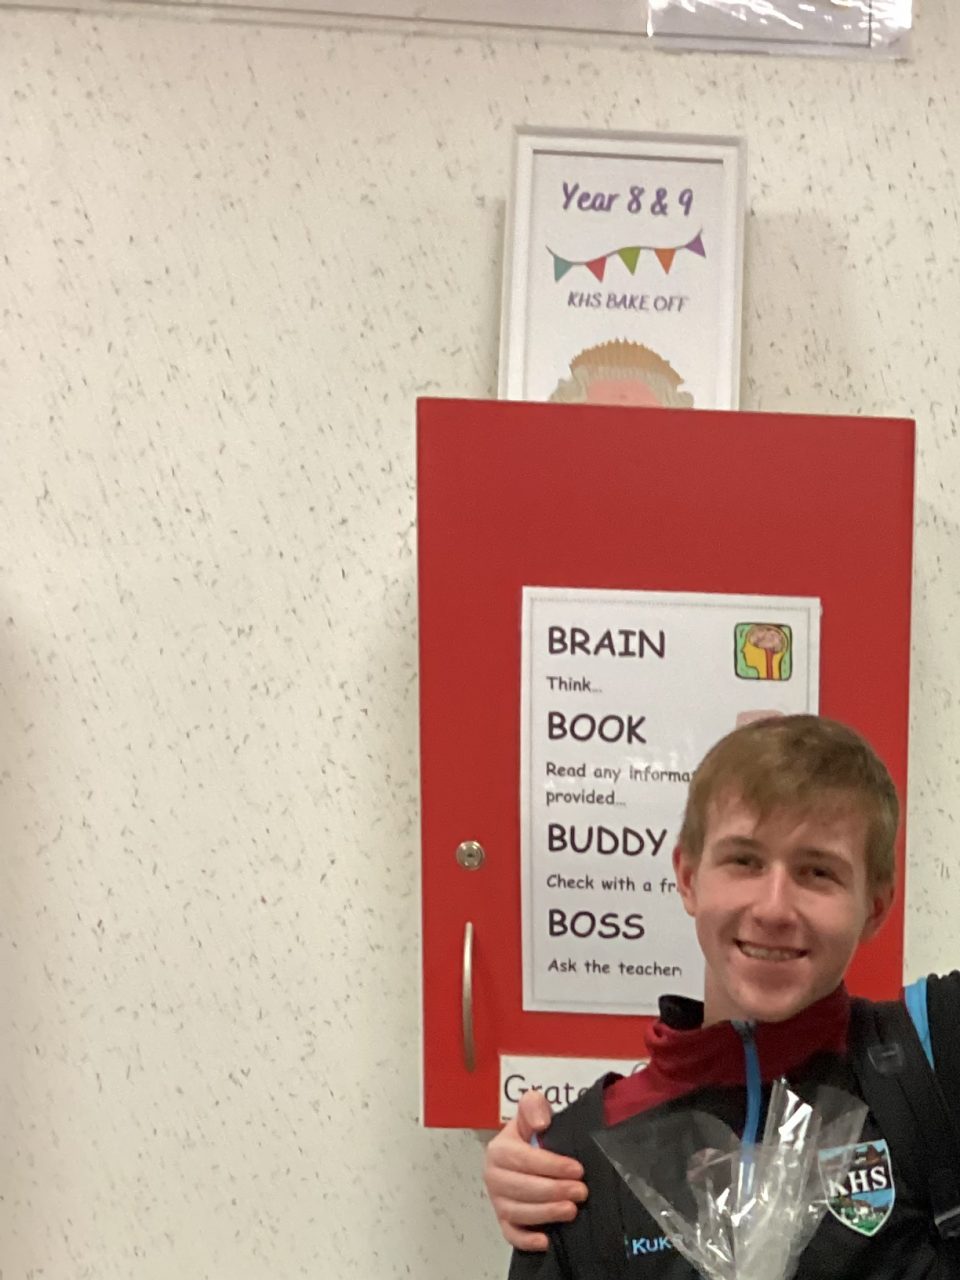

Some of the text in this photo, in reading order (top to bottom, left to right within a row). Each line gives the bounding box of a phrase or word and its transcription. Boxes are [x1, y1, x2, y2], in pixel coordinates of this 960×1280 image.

[562, 181, 694, 216] Year 8 & 9
[567, 290, 690, 313] KHS BAKE OFF
[547, 625, 666, 659] BRAIN
[547, 711, 647, 745] BOOK
[546, 761, 586, 778] Read
[594, 767, 621, 784] any
[548, 822, 667, 857] BUDDY
[546, 873, 594, 890] Check
[601, 876, 635, 892] with
[643, 881, 652, 893] a
[548, 908, 645, 940] BOSS
[547, 957, 577, 973] Ask
[584, 959, 610, 975] the
[828, 1165, 888, 1197] KHS
